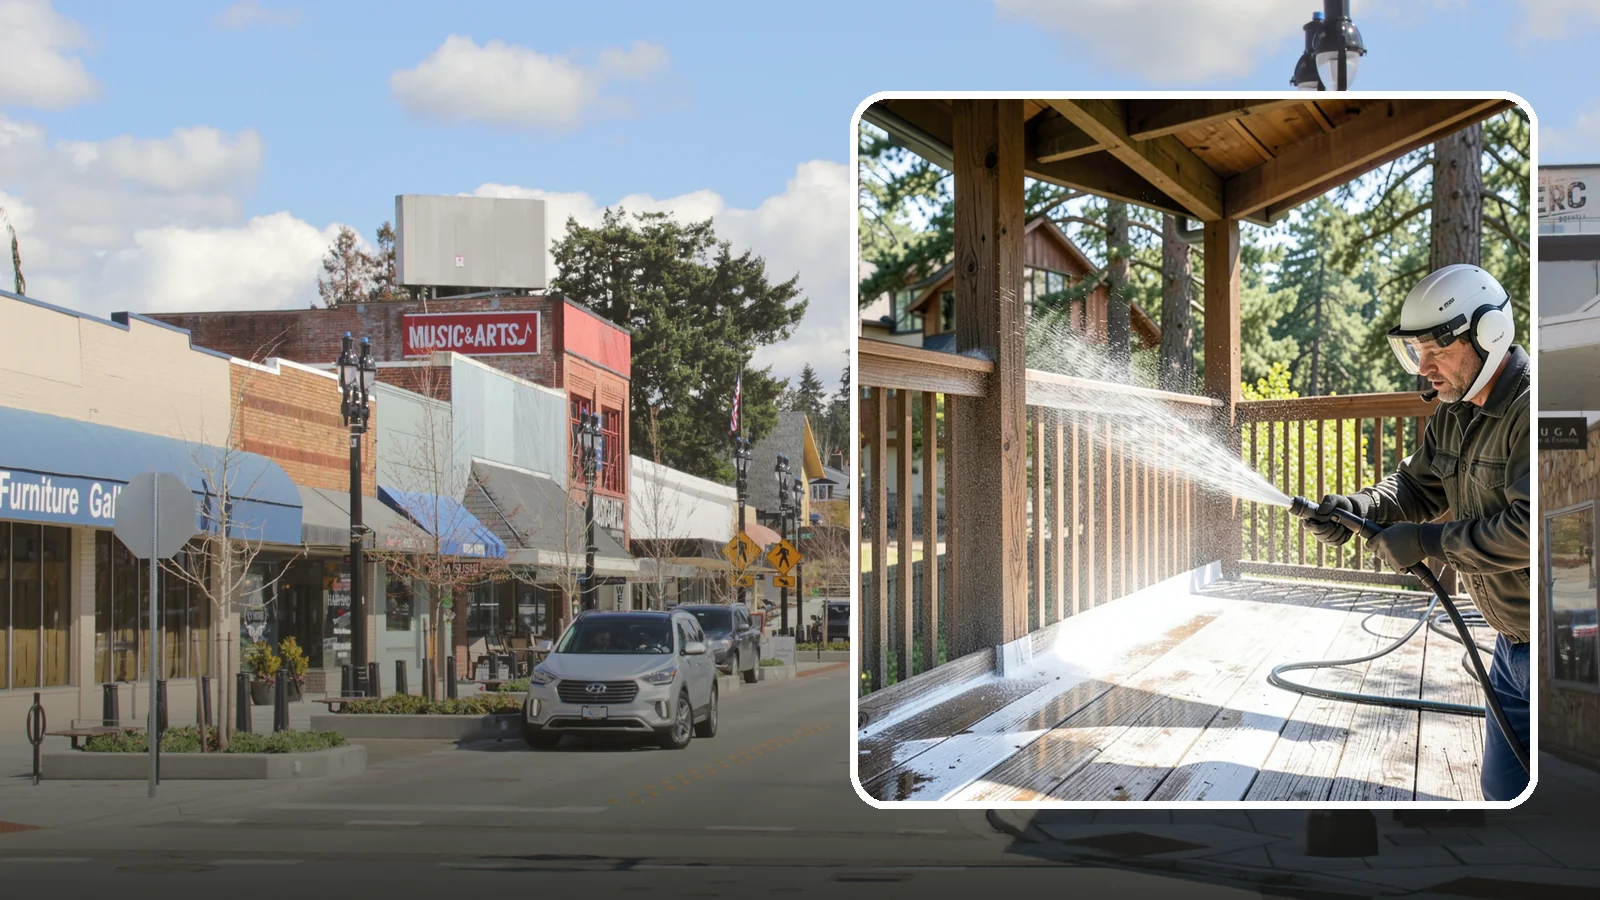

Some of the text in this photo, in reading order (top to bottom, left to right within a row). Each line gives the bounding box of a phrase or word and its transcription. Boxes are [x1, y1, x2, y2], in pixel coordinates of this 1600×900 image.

[1540, 428, 1577, 437] UGA
[0, 471, 79, 515] Furniture
[453, 563, 479, 574] SUSHI
